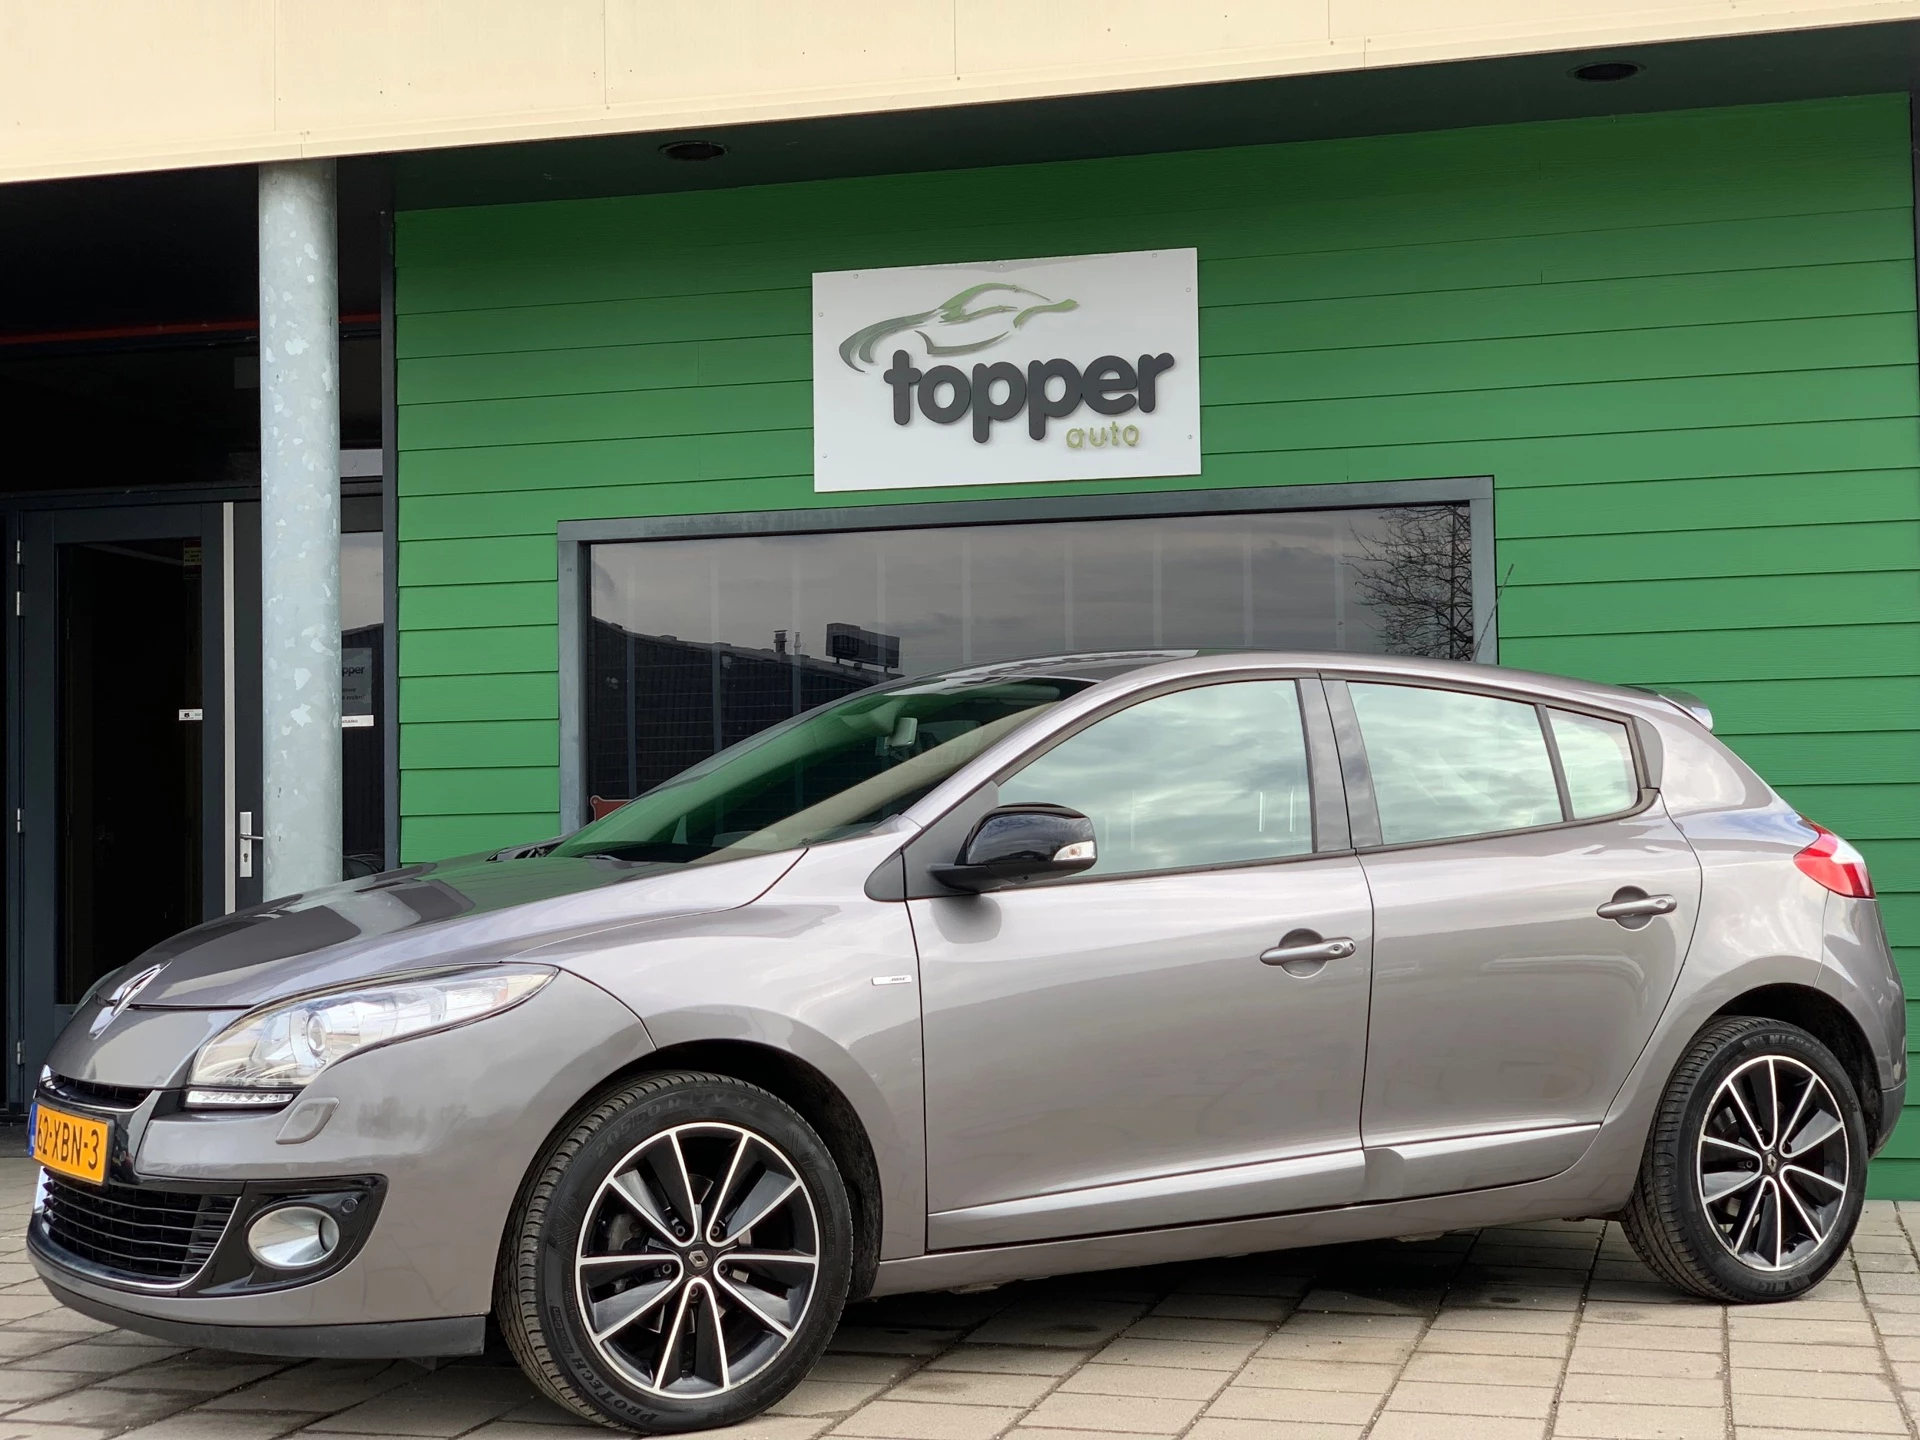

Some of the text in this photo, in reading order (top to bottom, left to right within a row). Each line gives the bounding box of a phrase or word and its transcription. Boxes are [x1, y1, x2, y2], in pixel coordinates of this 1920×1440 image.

[884, 349, 1175, 443] topper
[1066, 421, 1140, 449] auto
[342, 666, 365, 677] pper
[37, 1113, 100, 1171] 62-XBN-3
